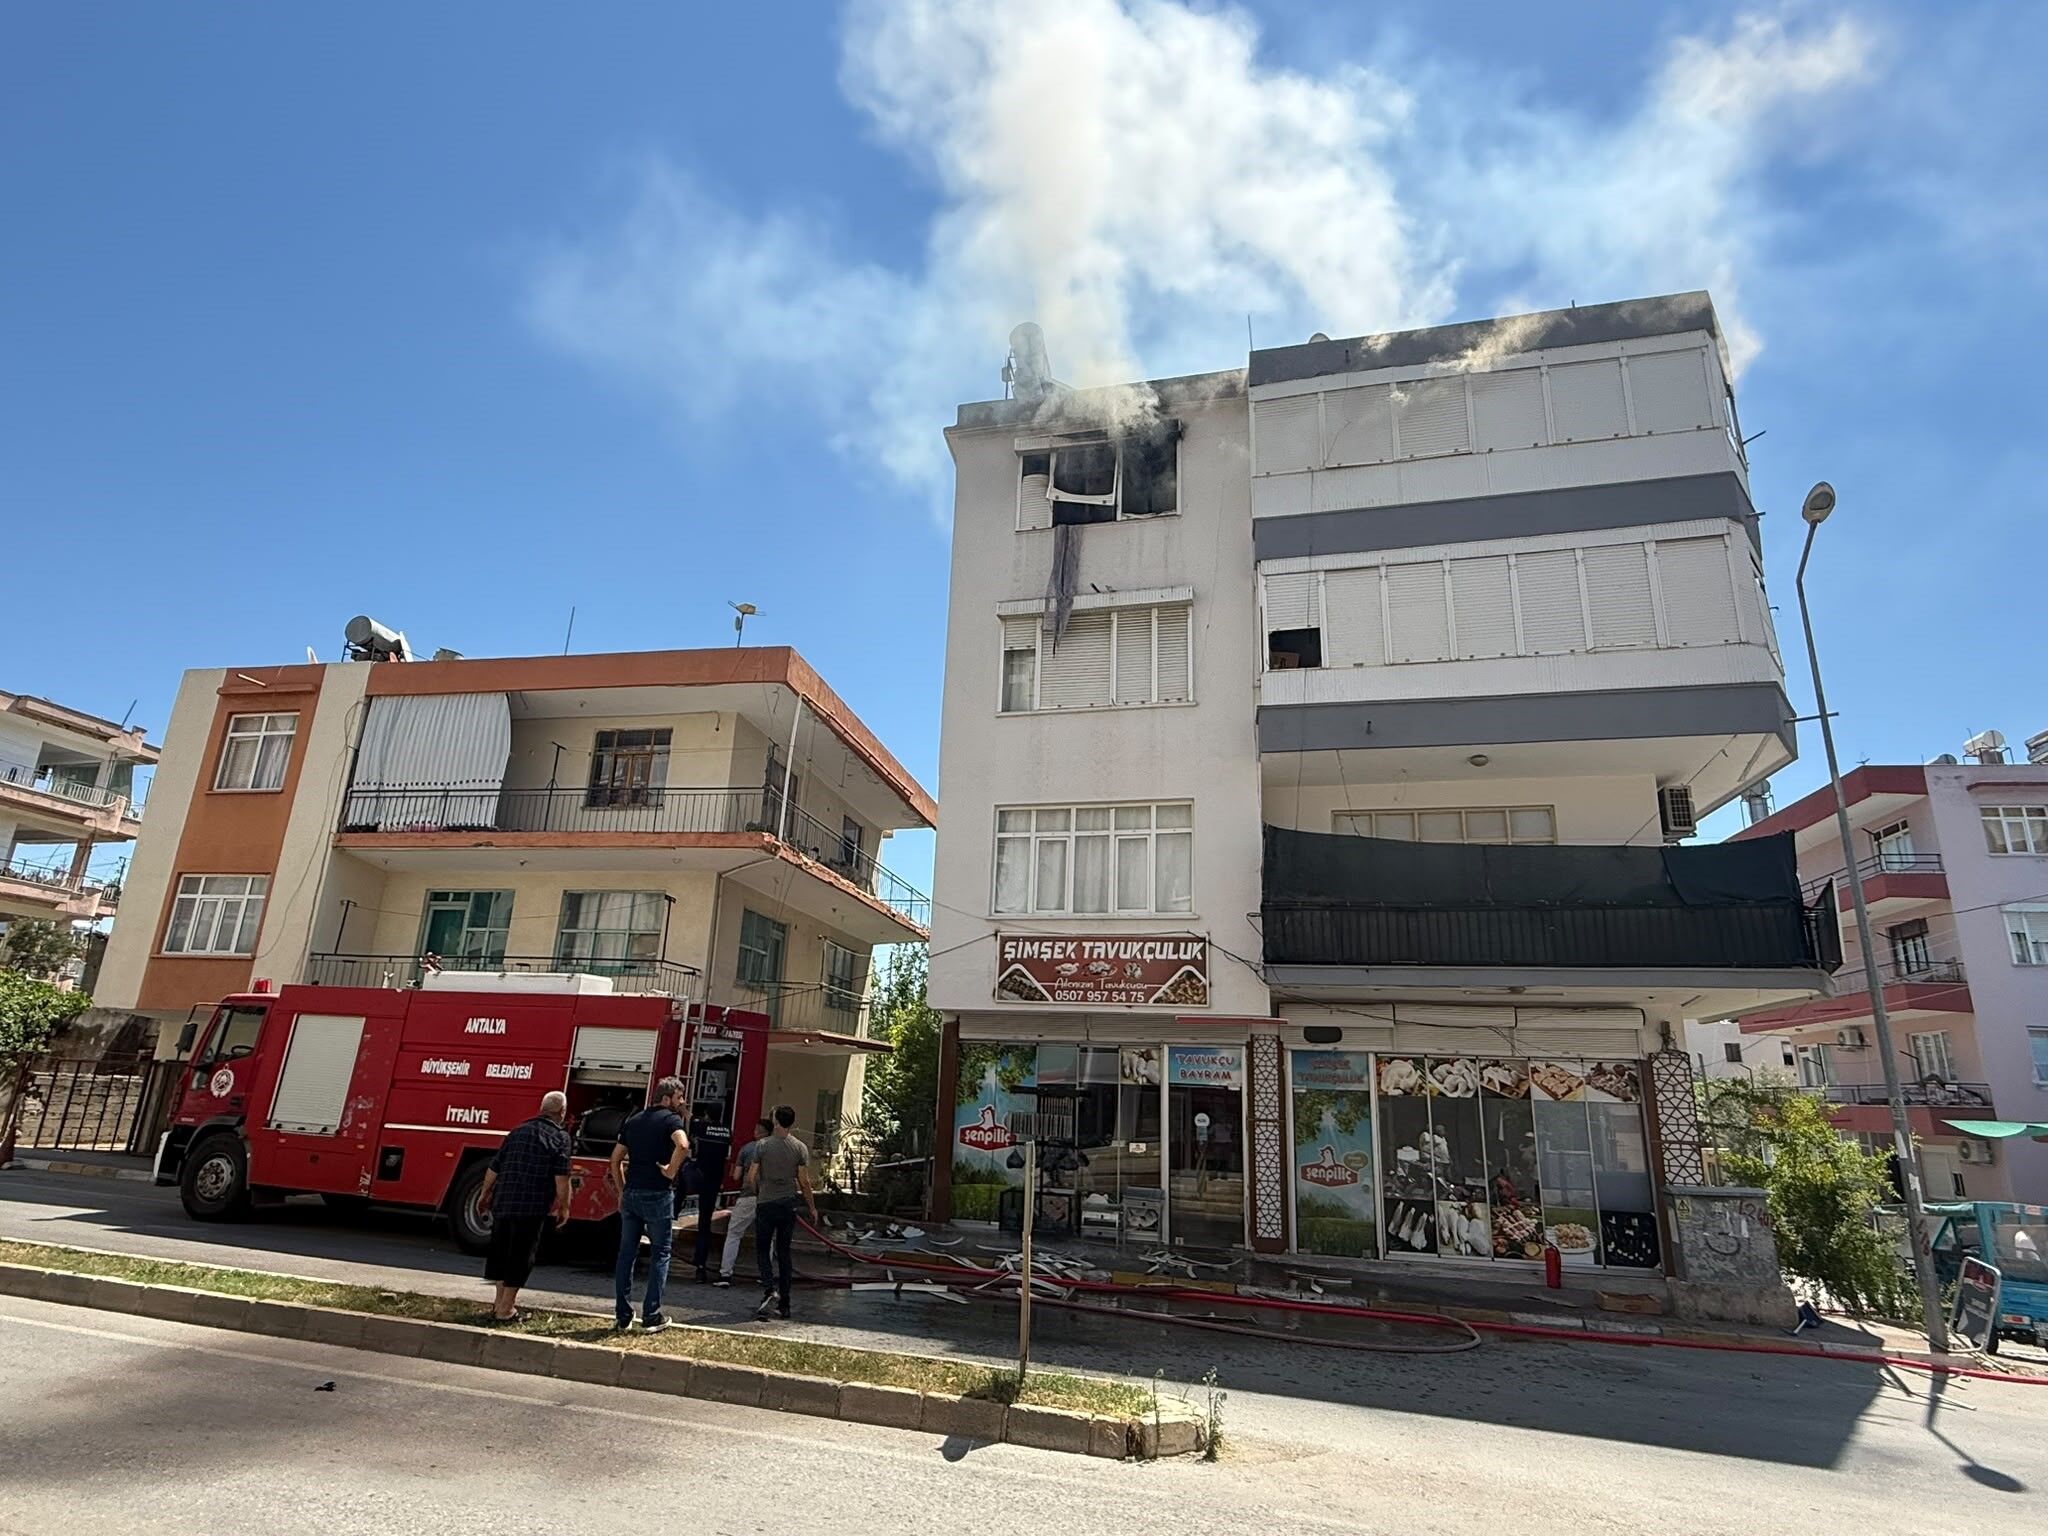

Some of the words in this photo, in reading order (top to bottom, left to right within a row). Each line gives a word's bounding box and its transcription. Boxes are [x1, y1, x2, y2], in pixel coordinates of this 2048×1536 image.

[1003, 938, 1077, 962] ŞİMŞEK
[1082, 941, 1205, 963] TAVUKÇULUK
[1055, 990, 1083, 1001] 0507
[1087, 991, 1108, 1001] 957
[1112, 991, 1126, 1002] 54
[1130, 991, 1144, 1002] 75
[464, 1017, 507, 1034] ANTALYA
[421, 1057, 471, 1077] BÜYÜKŞEHİR
[485, 1062, 533, 1079] BELEDİYESİ
[1175, 1053, 1234, 1066] TAVUKÇU
[1179, 1068, 1232, 1081] BAYRAM
[445, 1105, 490, 1124] İTFAİYE
[964, 1127, 1011, 1146] şenpiliç
[1306, 1166, 1352, 1183] şenpiliç
